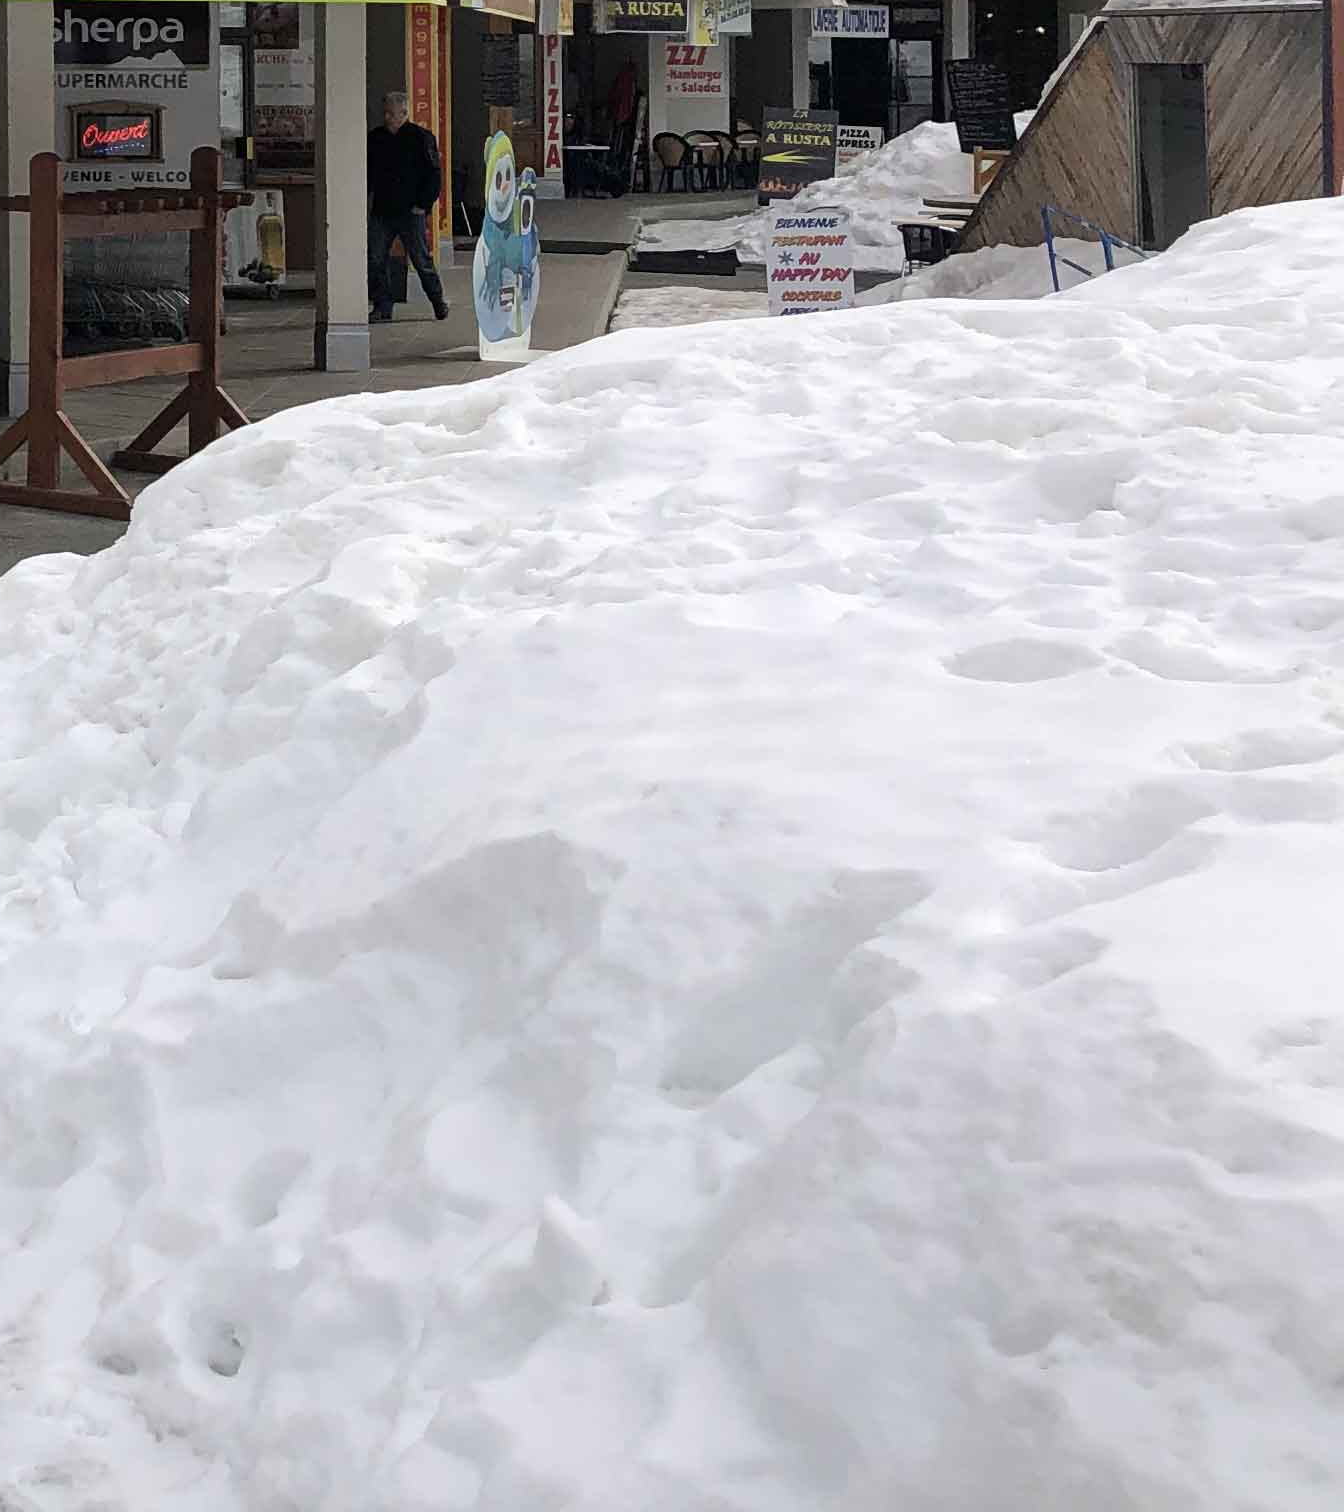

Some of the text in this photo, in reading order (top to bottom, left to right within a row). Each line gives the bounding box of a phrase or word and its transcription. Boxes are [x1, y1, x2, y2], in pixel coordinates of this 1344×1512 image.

[627, 0, 685, 16] RUSTA
[841, 7, 885, 33] AUTOMATIQUE
[54, 9, 185, 51] sherpa
[56, 69, 189, 89] UPERMARCHÉ
[545, 35, 562, 169] PIZZA
[766, 133, 831, 147] A RUSTA
[840, 129, 871, 139] PIZZA
[131, 171, 192, 183] WELCO
[775, 217, 839, 230] BIENVENUE
[799, 252, 821, 265] AU
[771, 268, 853, 282] HAPPY DAY
